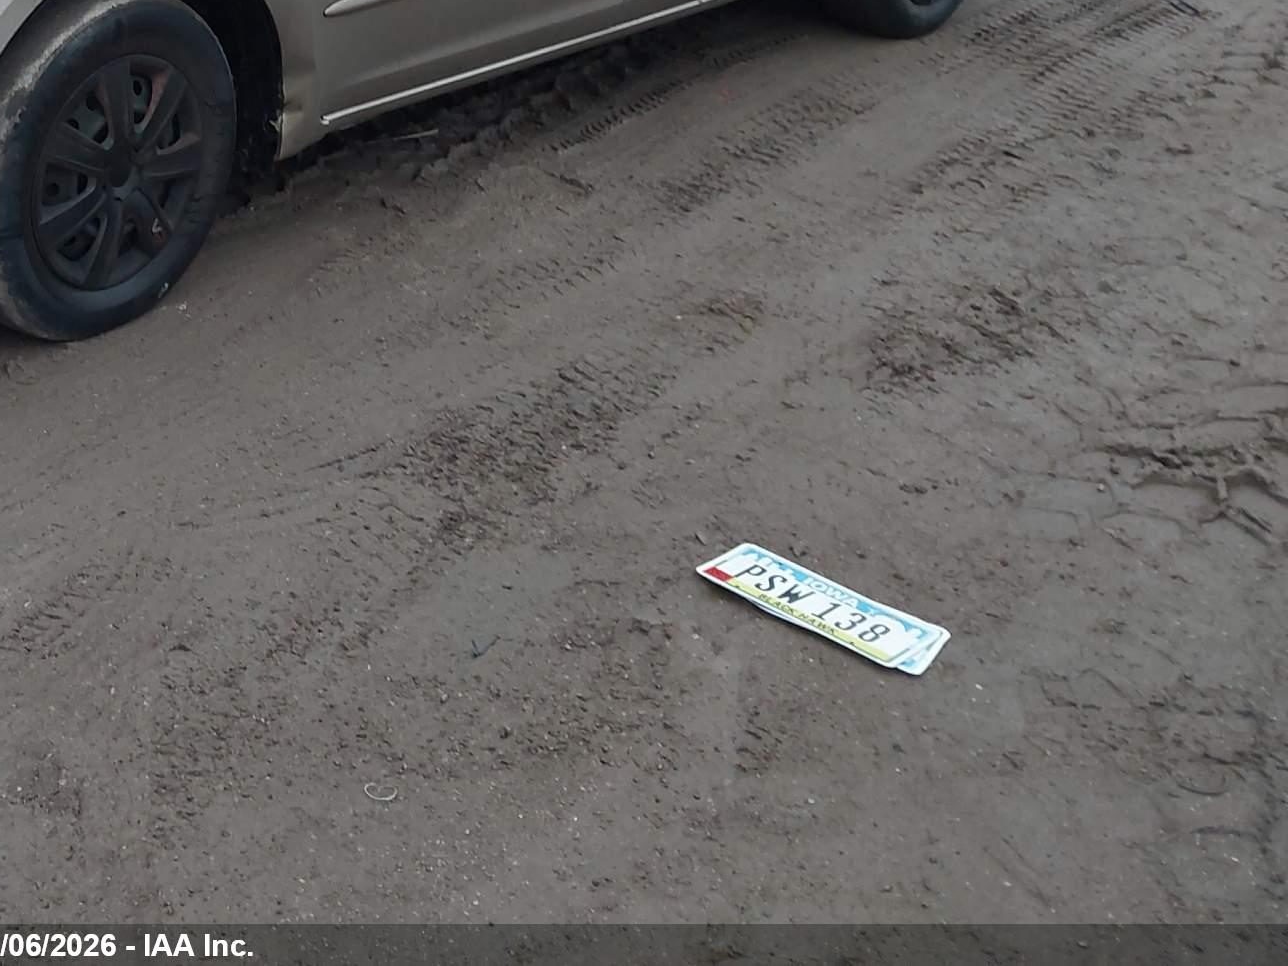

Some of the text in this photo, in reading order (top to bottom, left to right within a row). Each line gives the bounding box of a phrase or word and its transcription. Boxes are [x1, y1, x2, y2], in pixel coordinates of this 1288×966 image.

[733, 564, 891, 643] PSW 138
[806, 577, 859, 608] IOWA
[759, 593, 835, 635] BLACK HAWK
